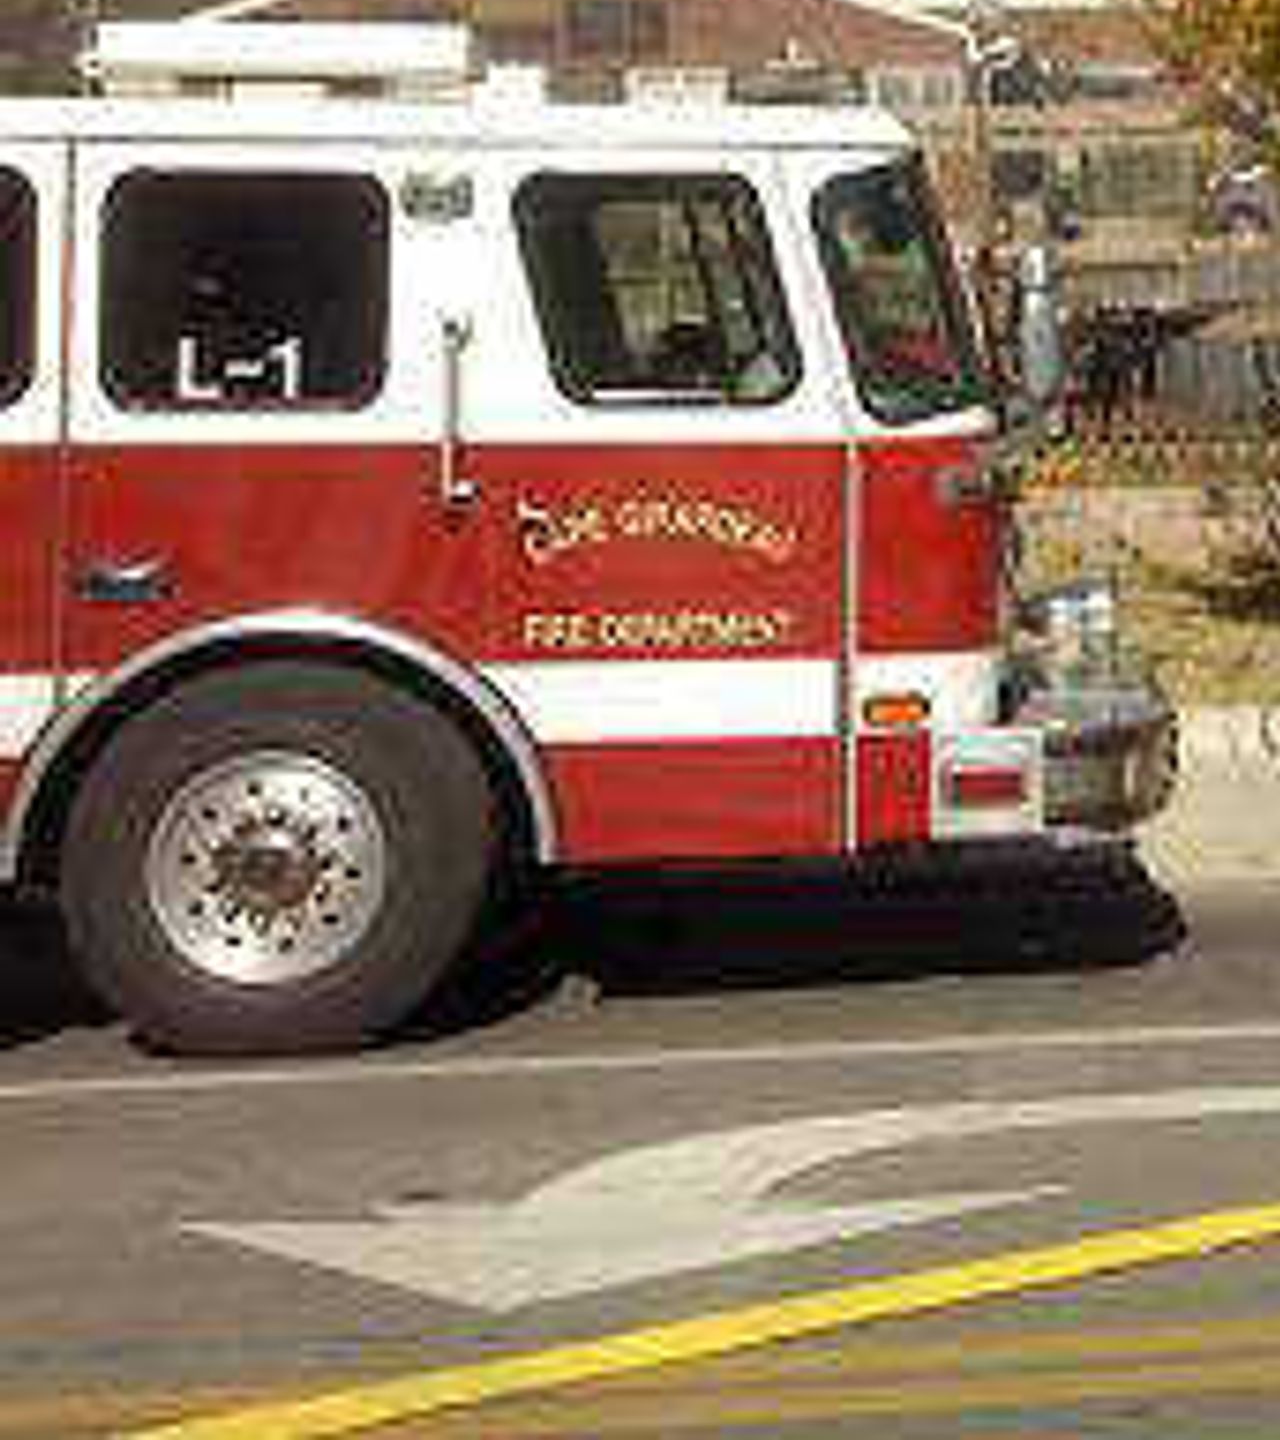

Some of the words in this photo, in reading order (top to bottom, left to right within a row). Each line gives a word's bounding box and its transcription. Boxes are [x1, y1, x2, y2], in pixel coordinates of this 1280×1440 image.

[178, 336, 302, 400] L-1
[523, 613, 596, 648] FIRE
[601, 611, 789, 648] DEPARTMENT
